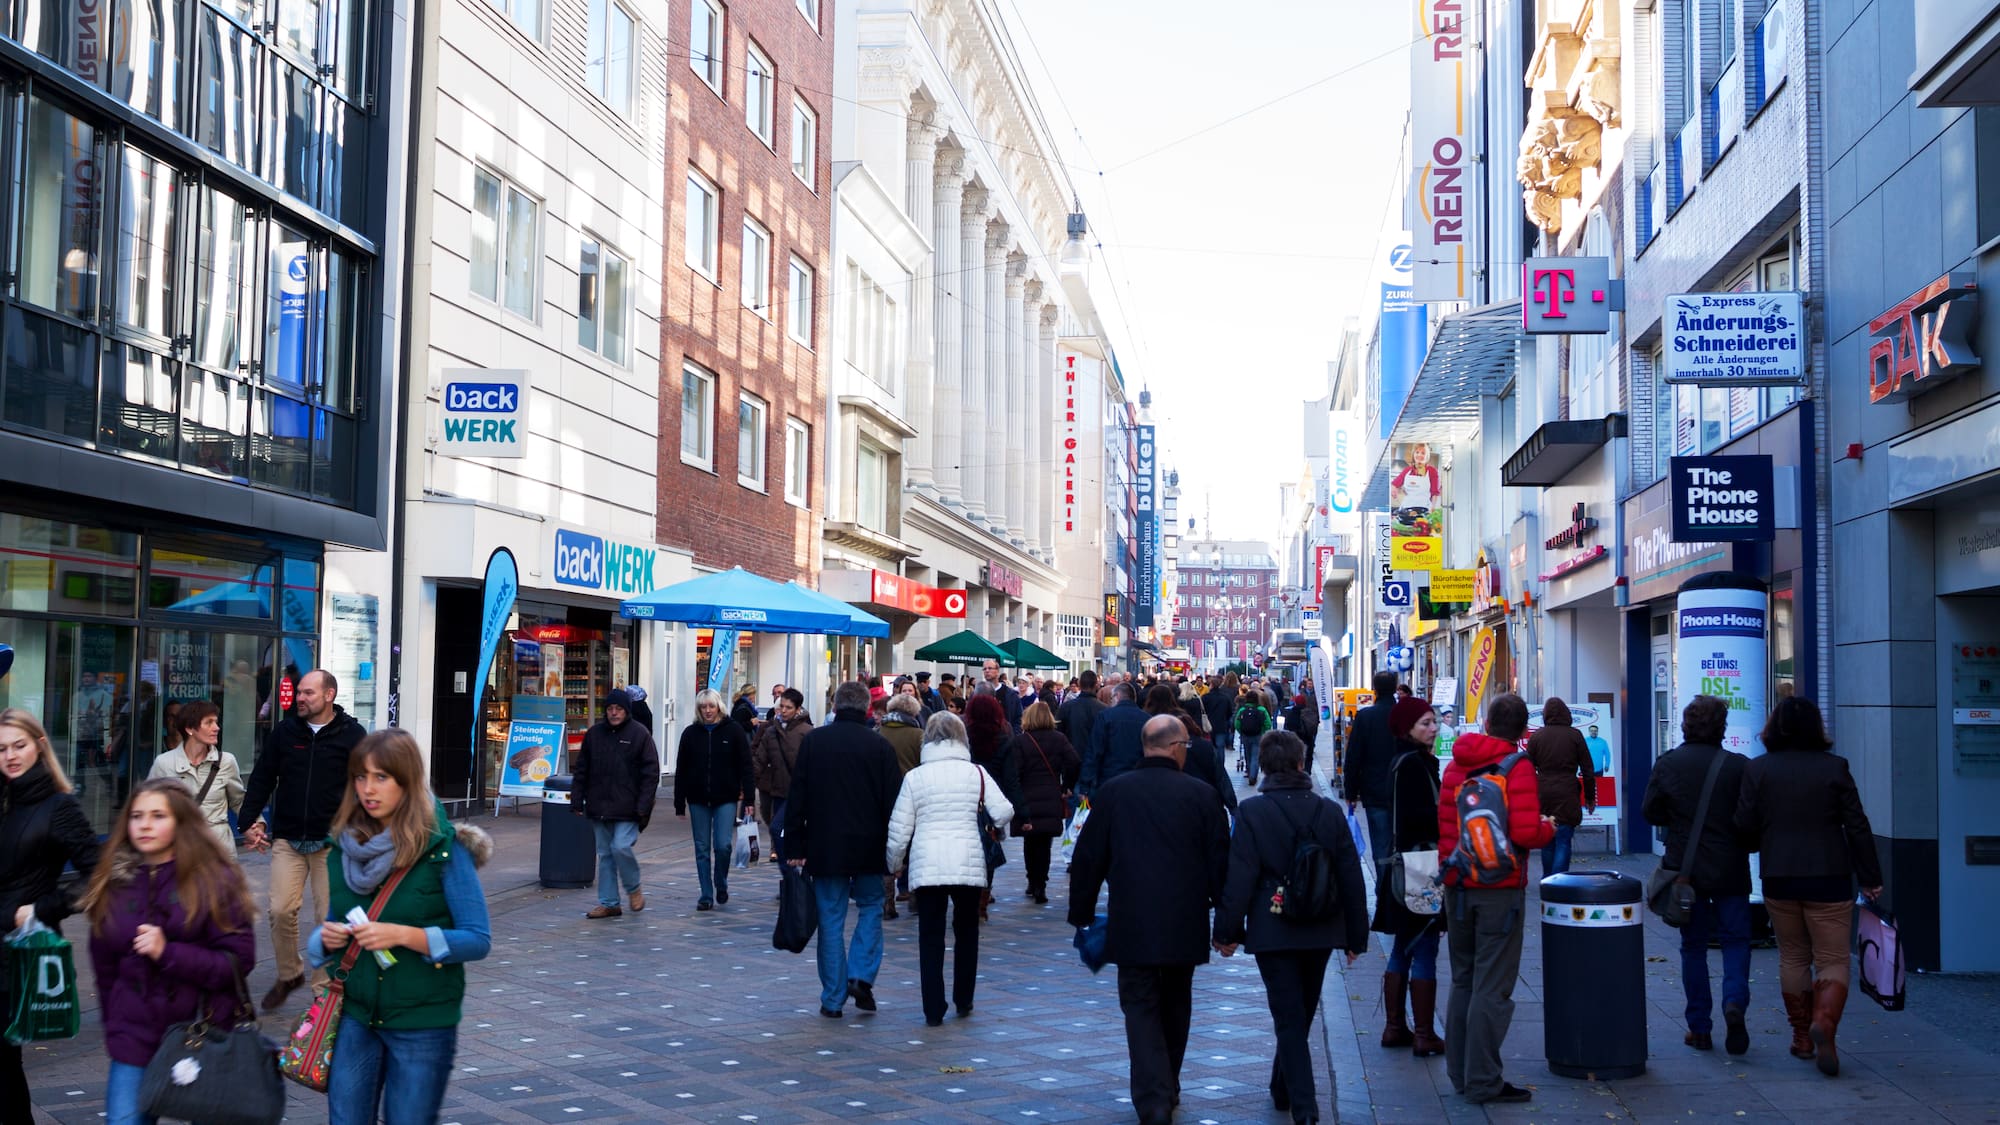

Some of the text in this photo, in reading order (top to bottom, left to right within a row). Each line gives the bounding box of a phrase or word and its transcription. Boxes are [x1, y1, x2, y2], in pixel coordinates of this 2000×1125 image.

[1433, 137, 1462, 245] RENO
[1702, 296, 1756, 309] Express
[1676, 311, 1795, 333] Änderungs-
[1674, 334, 1797, 352] Schneiderei
[1869, 290, 1951, 404] DAK
[1693, 353, 1778, 365] Alle Änderungen
[1675, 368, 1724, 377] innerhalb
[1727, 366, 1744, 376] 30
[1748, 367, 1789, 376] Minuten
[450, 385, 514, 410] back
[444, 418, 516, 443] WERK
[1065, 357, 1077, 531] THIER-GALERIE
[1138, 428, 1152, 511] büker
[1687, 468, 1732, 485] The
[1688, 487, 1758, 504] Phone
[1688, 507, 1758, 524] House
[1634, 535, 1652, 573] The
[1140, 521, 1153, 607] Einrichtungshaus
[1683, 614, 1762, 628] Phone House
[169, 644, 193, 656] DER
[169, 657, 192, 671] FÜR
[1470, 636, 1492, 696] RENO
[1701, 660, 1738, 670] BEI UNS!
[168, 685, 208, 698] KREDIT
[1701, 677, 1741, 696] DSL-
[512, 734, 544, 744] günstig
[514, 726, 555, 735] Steinofen-
[37, 955, 65, 997] D
